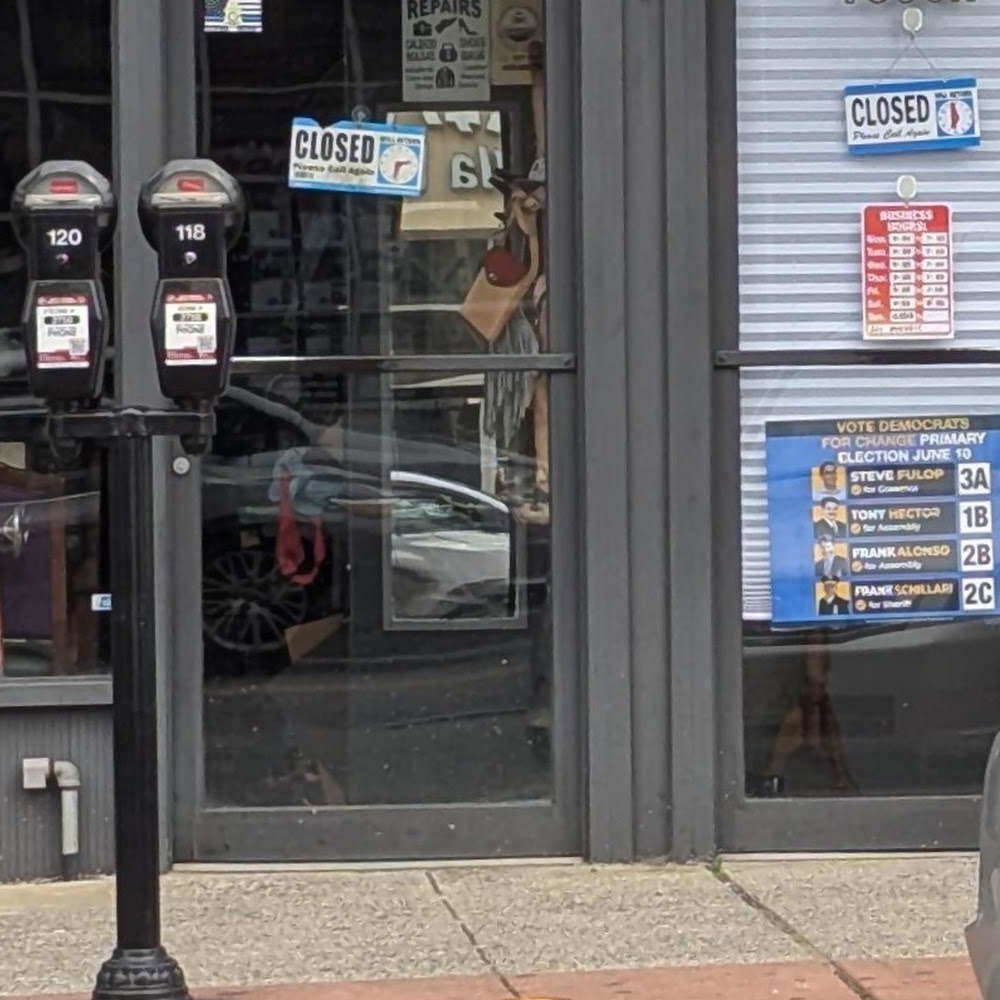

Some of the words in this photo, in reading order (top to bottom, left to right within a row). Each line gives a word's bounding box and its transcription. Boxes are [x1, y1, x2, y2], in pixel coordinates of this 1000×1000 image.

[852, 94, 930, 127] CLOSED
[295, 129, 375, 164] CLOSED
[47, 229, 82, 246] 120
[176, 224, 206, 241] 118
[837, 421, 874, 433] VOTE
[879, 418, 969, 432] DEMOCRATS
[822, 437, 850, 448] FOR
[855, 434, 915, 447] CHANGE
[920, 432, 986, 446] PRIMARY
[838, 450, 908, 463] ELECTION
[913, 449, 951, 460] JUNE
[956, 448, 972, 459] 10
[850, 470, 894, 482] STEVE
[897, 468, 944, 480] FULOP
[960, 468, 989, 490] 3A
[851, 509, 886, 520] TONY
[888, 507, 940, 519] HECTOR
[963, 505, 988, 528] 1B
[852, 546, 896, 558] FRANK
[897, 545, 950, 556] ALONSO
[963, 544, 991, 566] 2B
[855, 585, 893, 597] FRANK
[964, 582, 992, 604] 2C
